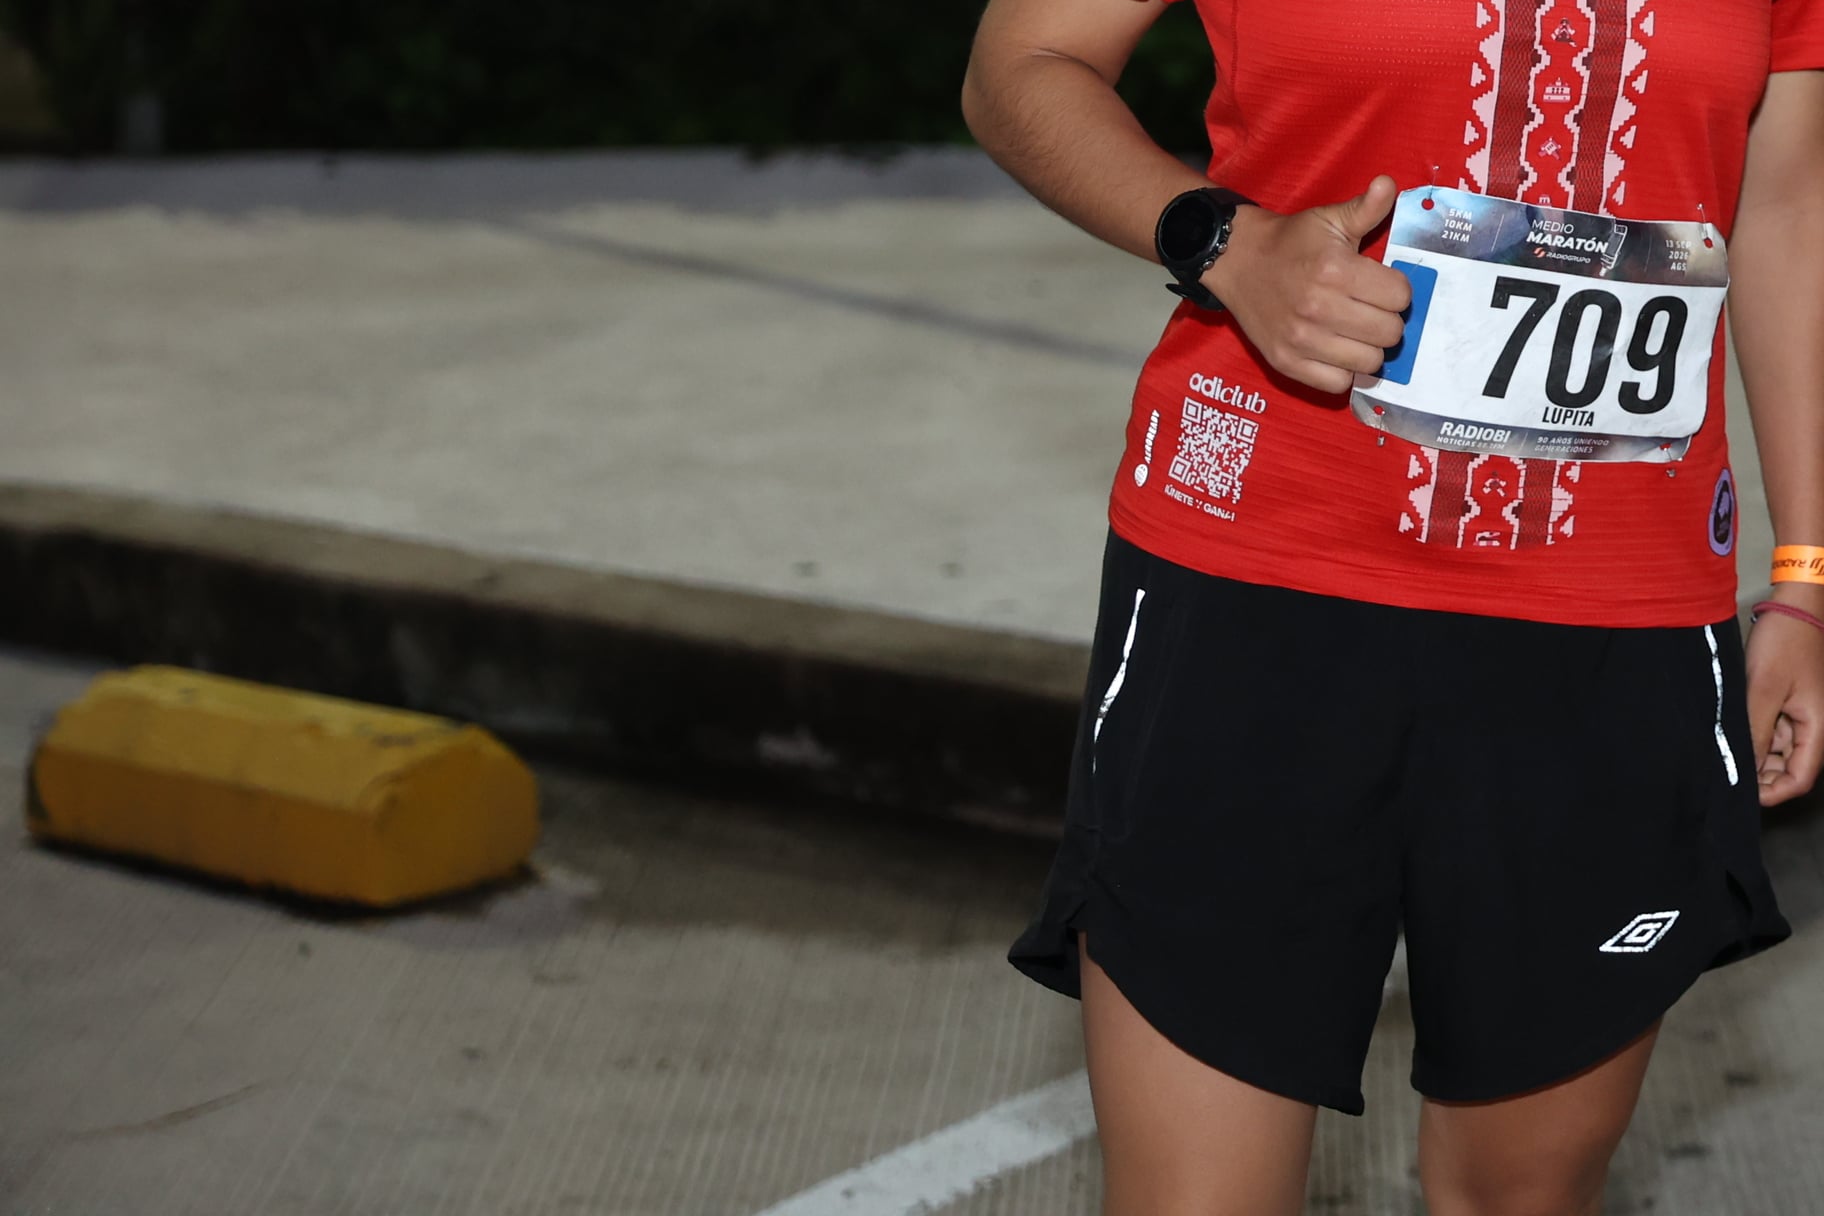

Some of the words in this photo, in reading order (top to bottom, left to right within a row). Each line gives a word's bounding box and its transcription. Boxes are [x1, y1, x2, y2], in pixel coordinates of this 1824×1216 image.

[1448, 208, 1473, 220] 5KM
[1444, 218, 1473, 232] 10KM
[1532, 219, 1574, 234] MEDIO
[1441, 230, 1470, 243] 21KM
[1526, 231, 1609, 254] MARATÓN
[1482, 275, 1688, 415] 709
[1189, 372, 1267, 414] adiclub
[1542, 407, 1595, 427] LUPITA
[1440, 422, 1511, 443] RADIOBI
[1436, 436, 1476, 448] NOTICIAS
[1550, 437, 1573, 445] AÑOS
[1573, 438, 1610, 447] UNIENDO
[1534, 445, 1593, 454] GENERACIONES
